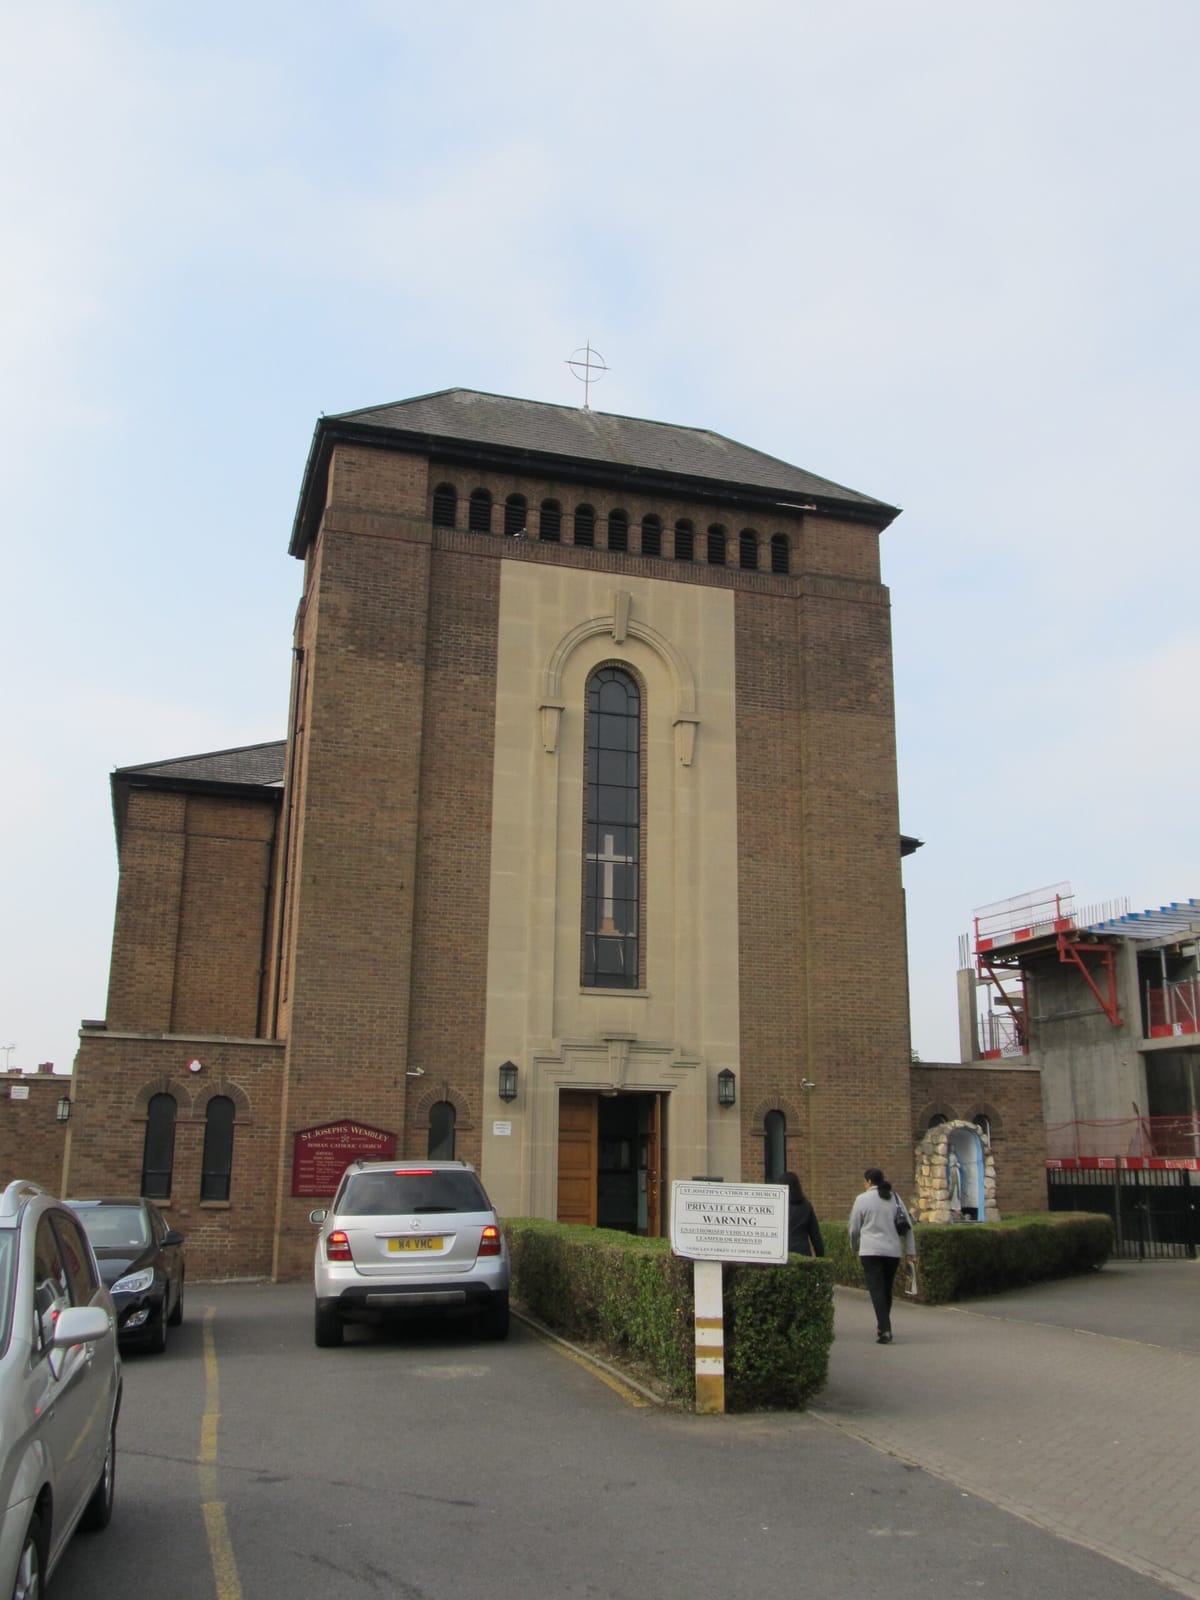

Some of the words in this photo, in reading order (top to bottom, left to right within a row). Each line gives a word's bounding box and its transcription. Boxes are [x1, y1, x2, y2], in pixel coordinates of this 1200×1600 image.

[351, 1126, 389, 1142] WEMBLEY
[687, 1203, 723, 1211] PRIVATE
[727, 1205, 748, 1213] CAR
[748, 1206, 772, 1214] PARK
[702, 1215, 757, 1226] WARNING
